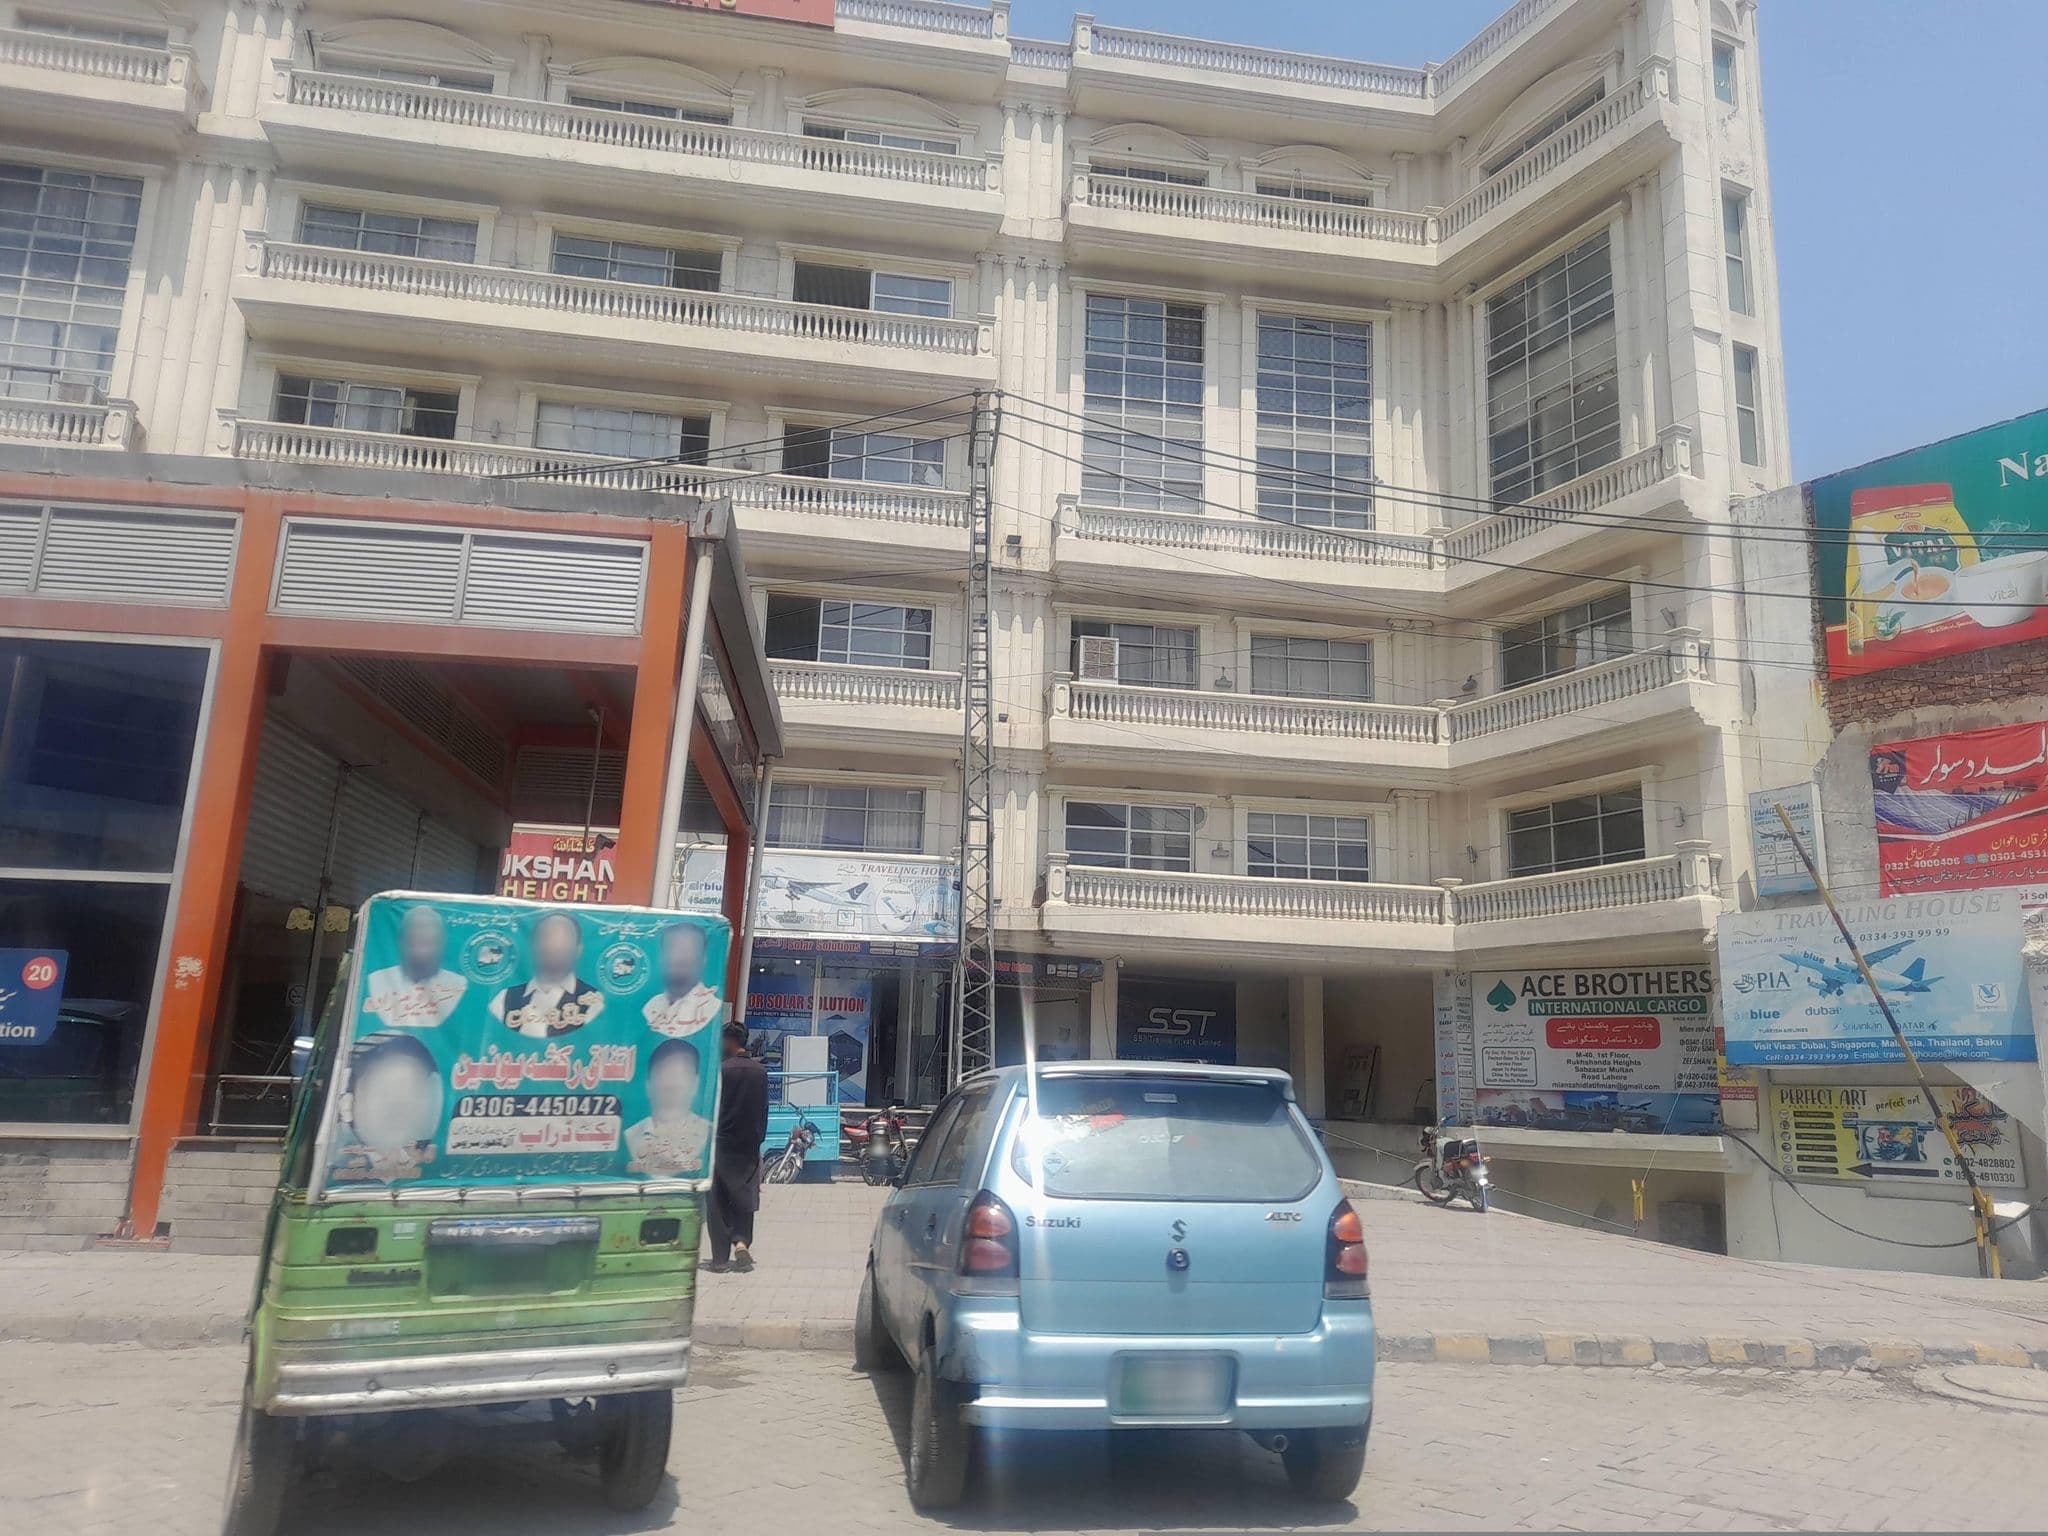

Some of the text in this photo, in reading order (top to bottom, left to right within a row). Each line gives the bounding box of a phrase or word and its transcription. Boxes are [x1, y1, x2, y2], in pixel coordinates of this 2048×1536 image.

[1920, 744, 1965, 784] سولر
[860, 863, 918, 876] TRAVELING
[920, 865, 960, 878] HOUSE
[1901, 893, 2004, 919] HOUSE
[27, 964, 53, 982] 20
[1757, 972, 1790, 989] PIA
[1520, 970, 1714, 998] ACE BROTHERS
[767, 994, 804, 1010] SOLAR
[1530, 998, 1701, 1015] INTERNATIONAL CARGO
[1137, 1007, 1217, 1036] SST
[1577, 1020, 1610, 1032] پاکستان
[1612, 1024, 1630, 1032] سے
[1881, 1039, 1925, 1049] Malsia,
[1975, 1037, 2003, 1047] Baku
[1780, 1088, 1868, 1106] PERFECT ART
[1875, 1095, 1921, 1112] perfect art
[459, 1096, 617, 1117] 0306-4450472
[1025, 1216, 1082, 1229] Suzuki
